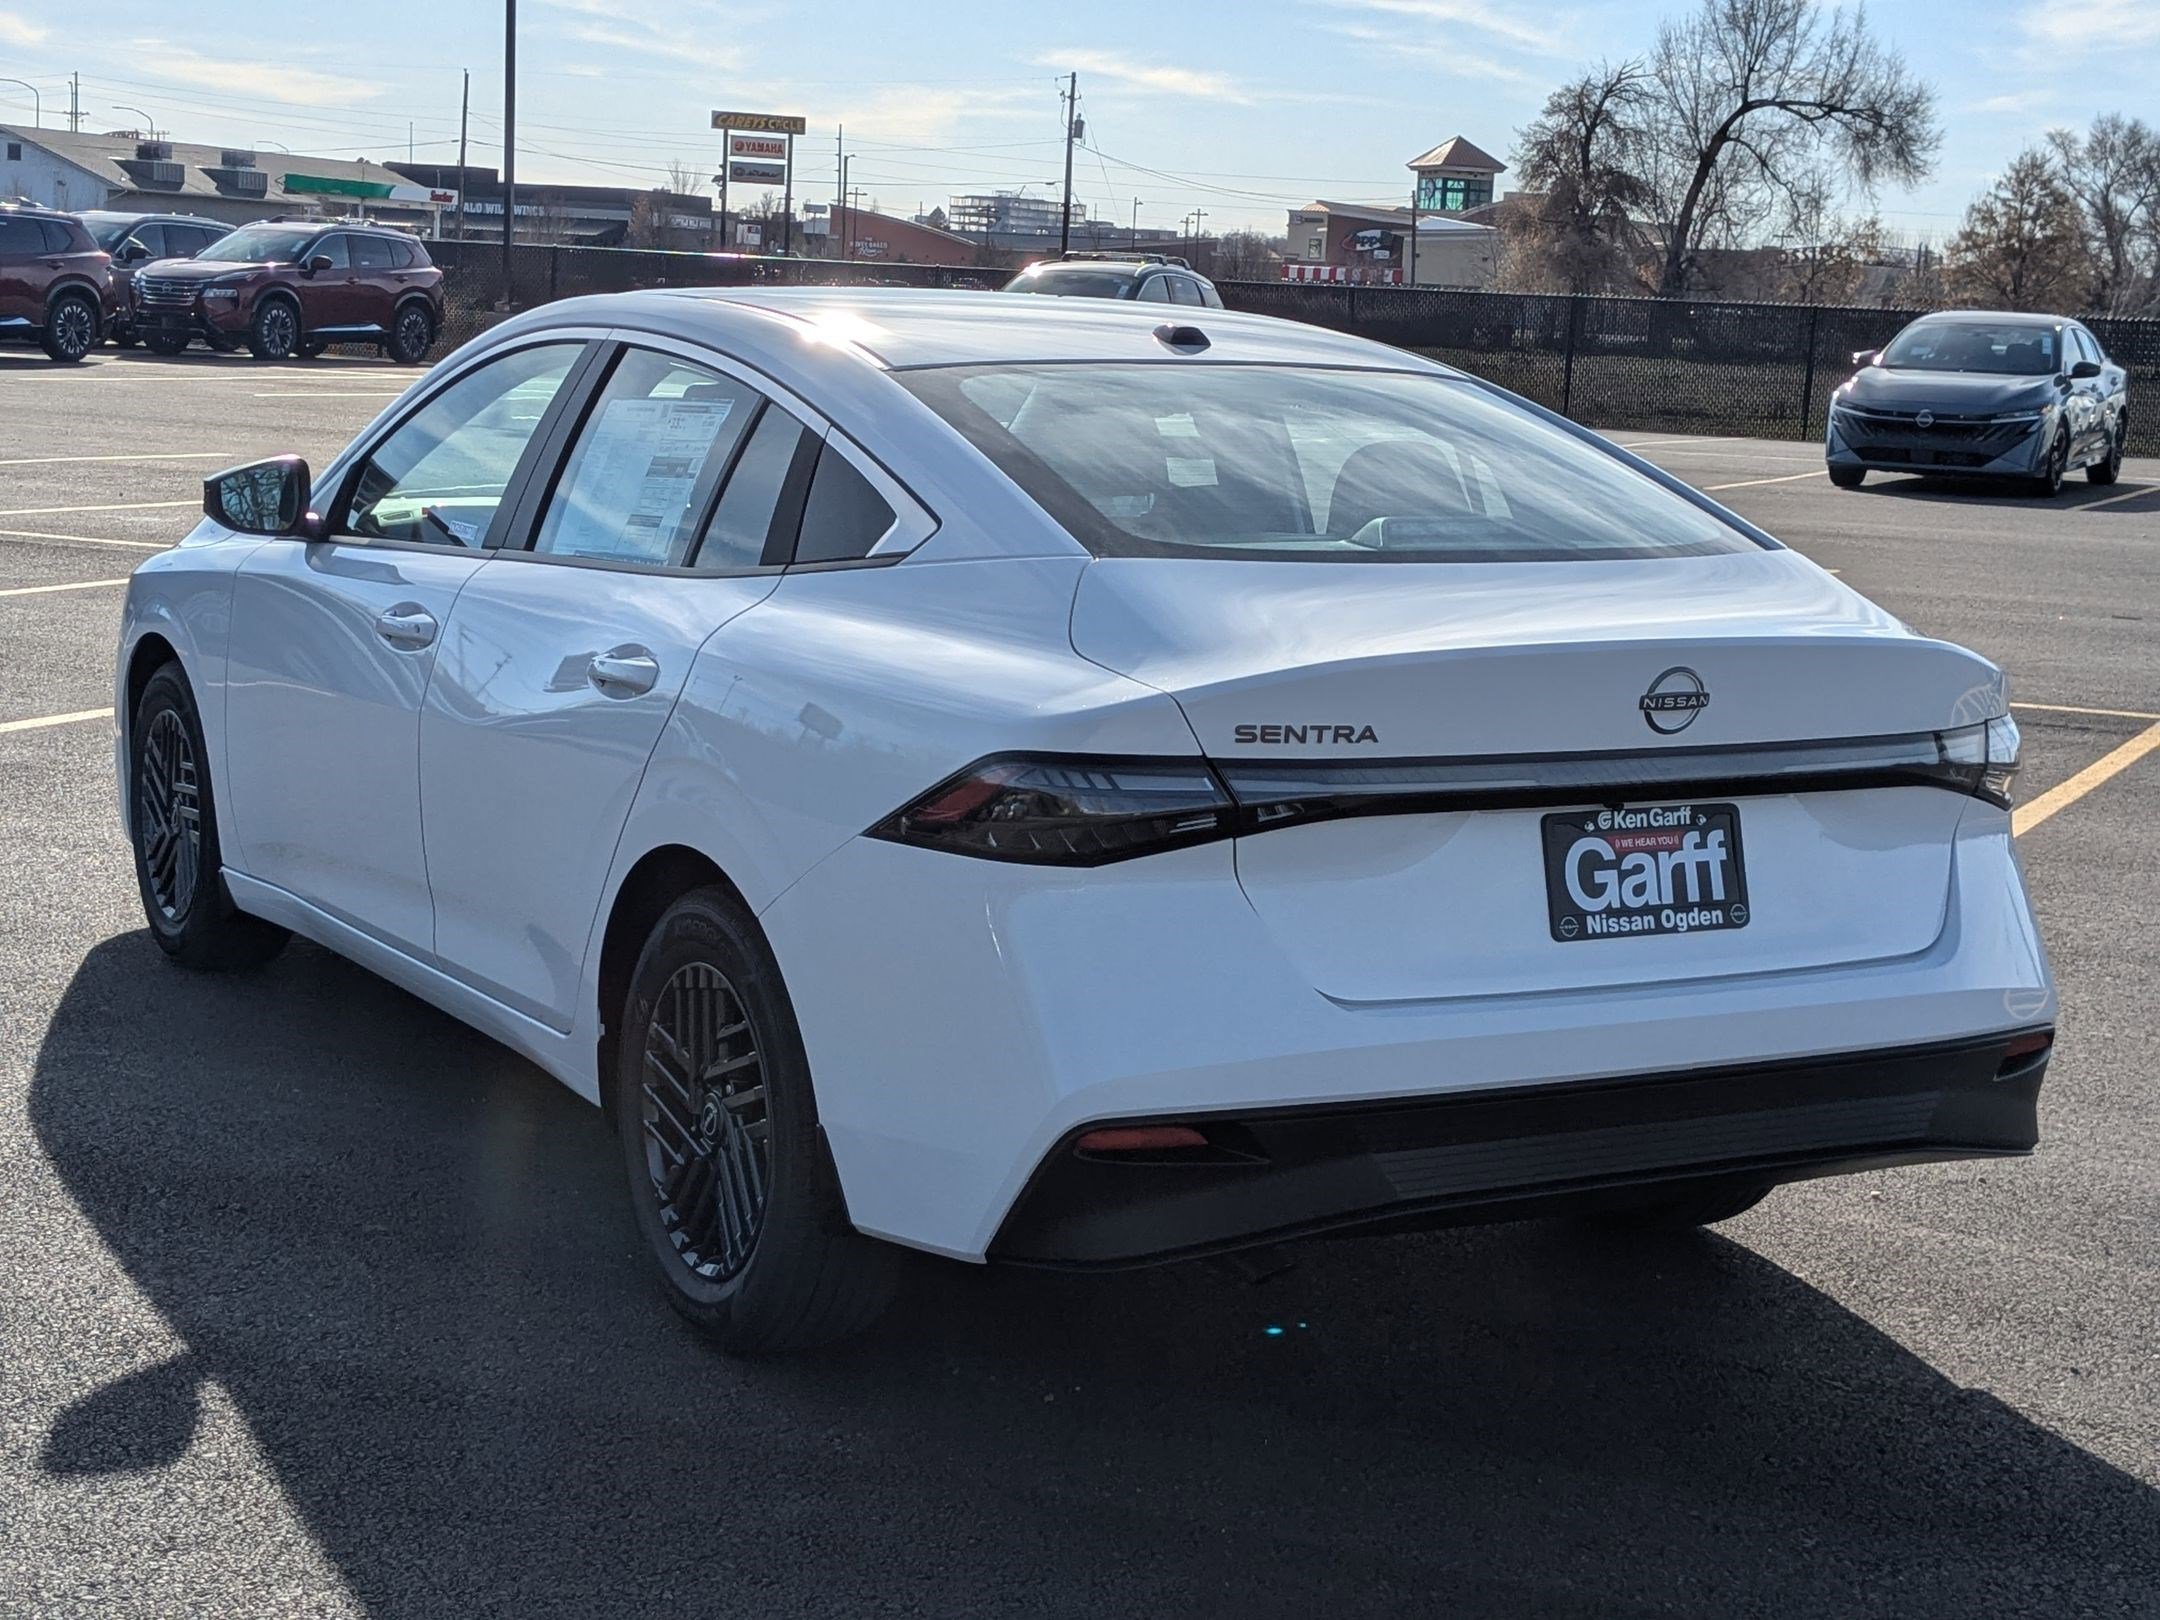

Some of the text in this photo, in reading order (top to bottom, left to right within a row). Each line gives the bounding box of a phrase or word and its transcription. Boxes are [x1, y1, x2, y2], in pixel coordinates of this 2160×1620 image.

[745, 141, 784, 154] YAMAHA
[1643, 696, 1709, 708] NISSAN
[1234, 724, 1379, 744] SENTRA
[1613, 806, 1692, 830] Ken Garff
[1621, 836, 1674, 848] WE HEAR YOU
[1564, 829, 1728, 913] Garff
[1585, 907, 1724, 934] Nissan Ogden
